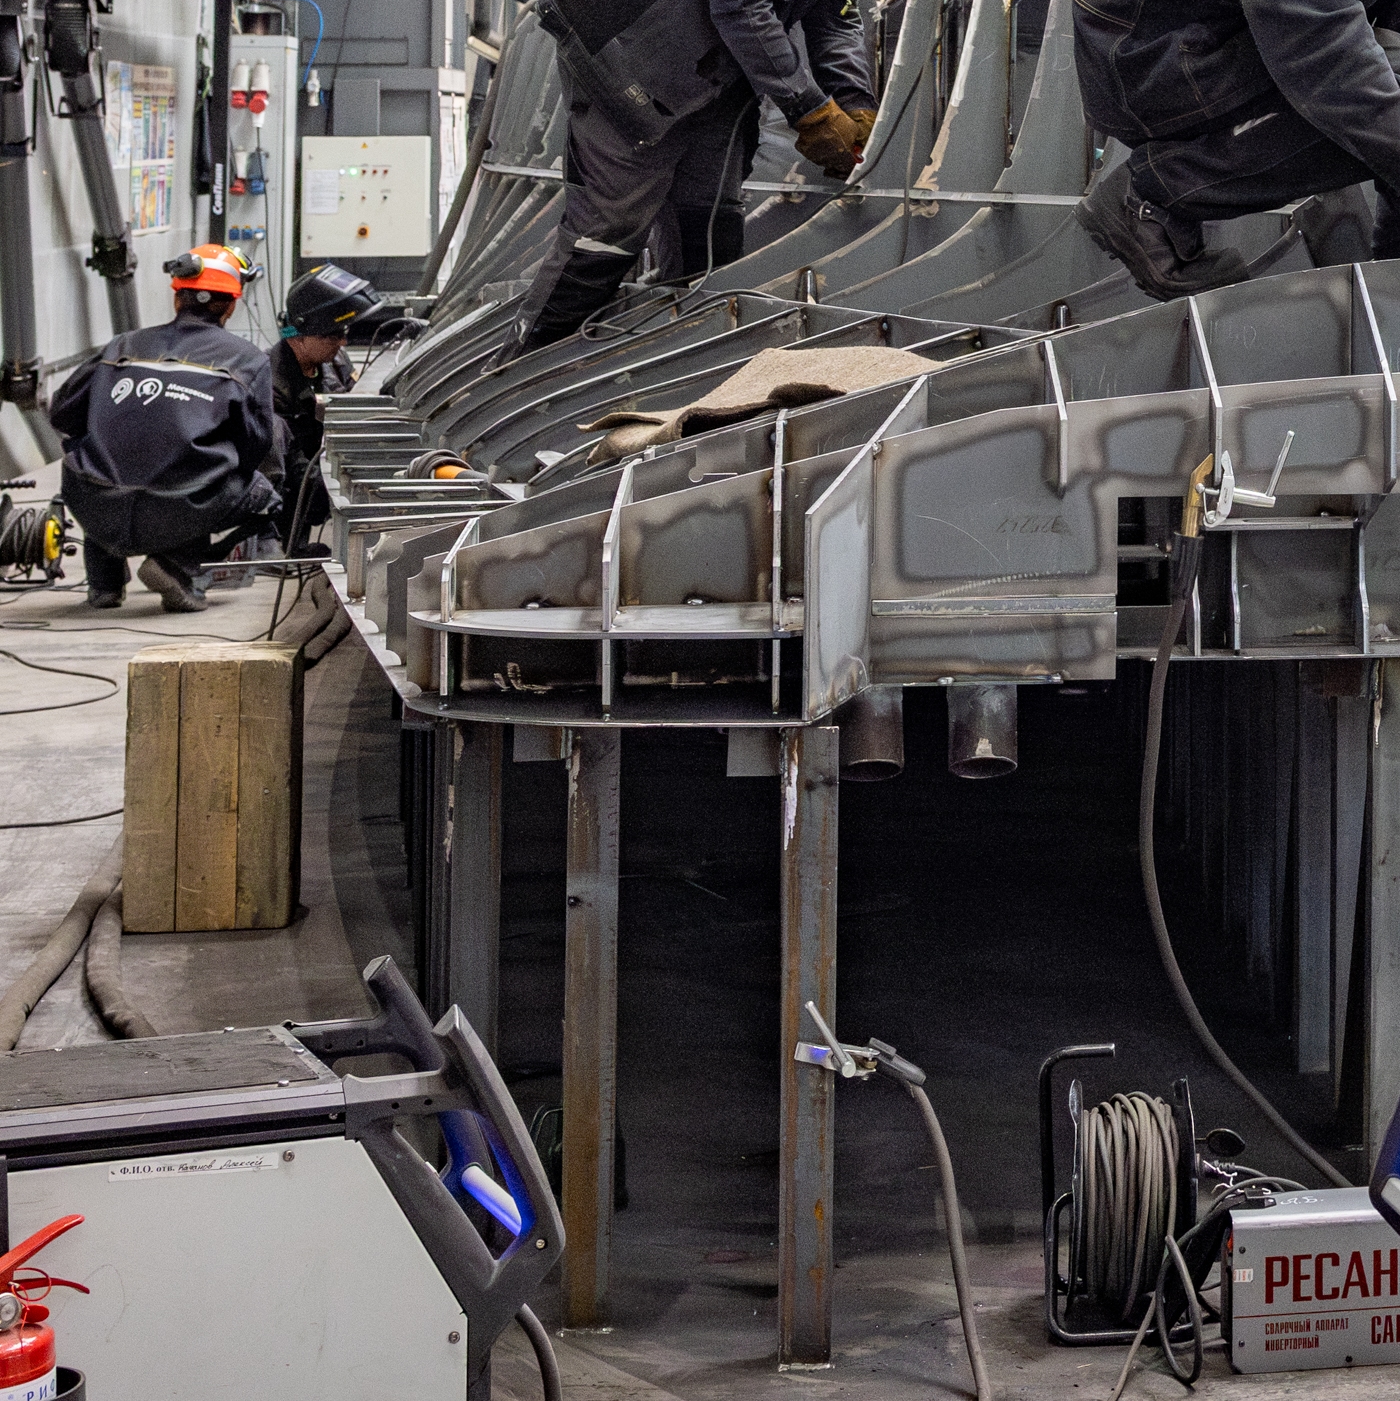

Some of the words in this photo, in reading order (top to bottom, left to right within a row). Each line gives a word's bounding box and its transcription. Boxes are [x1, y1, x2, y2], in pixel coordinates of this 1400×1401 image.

[119, 1165, 154, 1175] Ф.И.О.
[1265, 1318, 1311, 1335] СВАРОЧНЫЙ
[1315, 1317, 1349, 1331] АППАРАТ
[1265, 1335, 1320, 1351] ИНВЕРТОРНЫЙ
